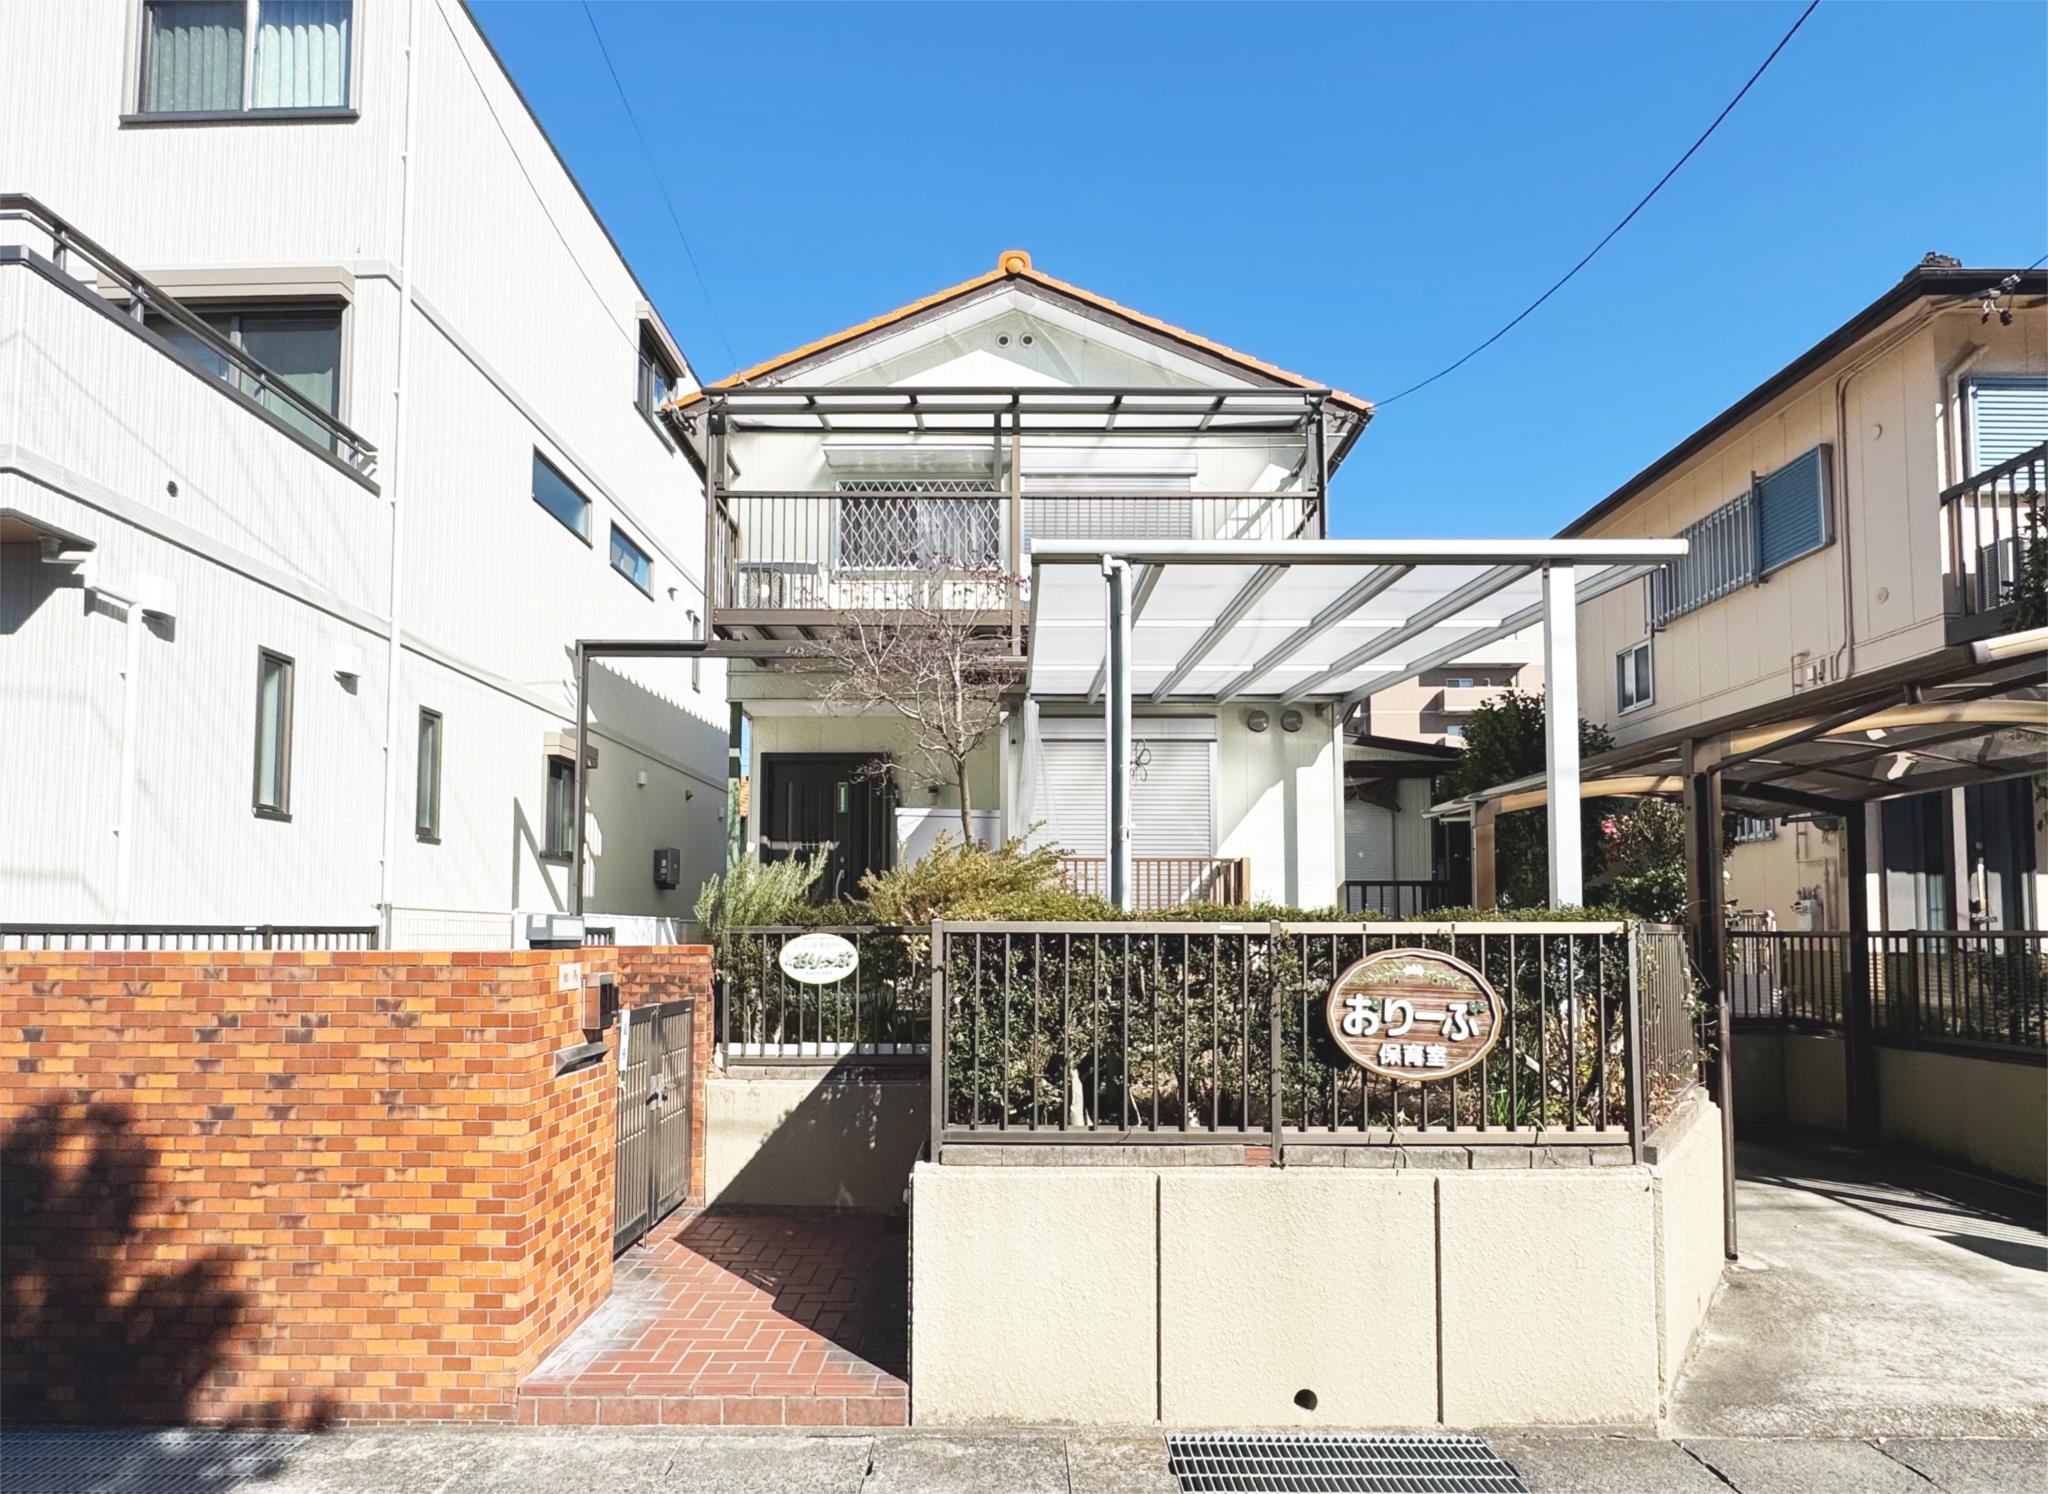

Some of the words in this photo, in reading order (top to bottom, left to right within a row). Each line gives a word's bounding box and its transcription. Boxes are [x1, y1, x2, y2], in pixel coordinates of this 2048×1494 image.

[1342, 993, 1488, 1041] おりーぶ
[1378, 1043, 1447, 1067] 保育室
